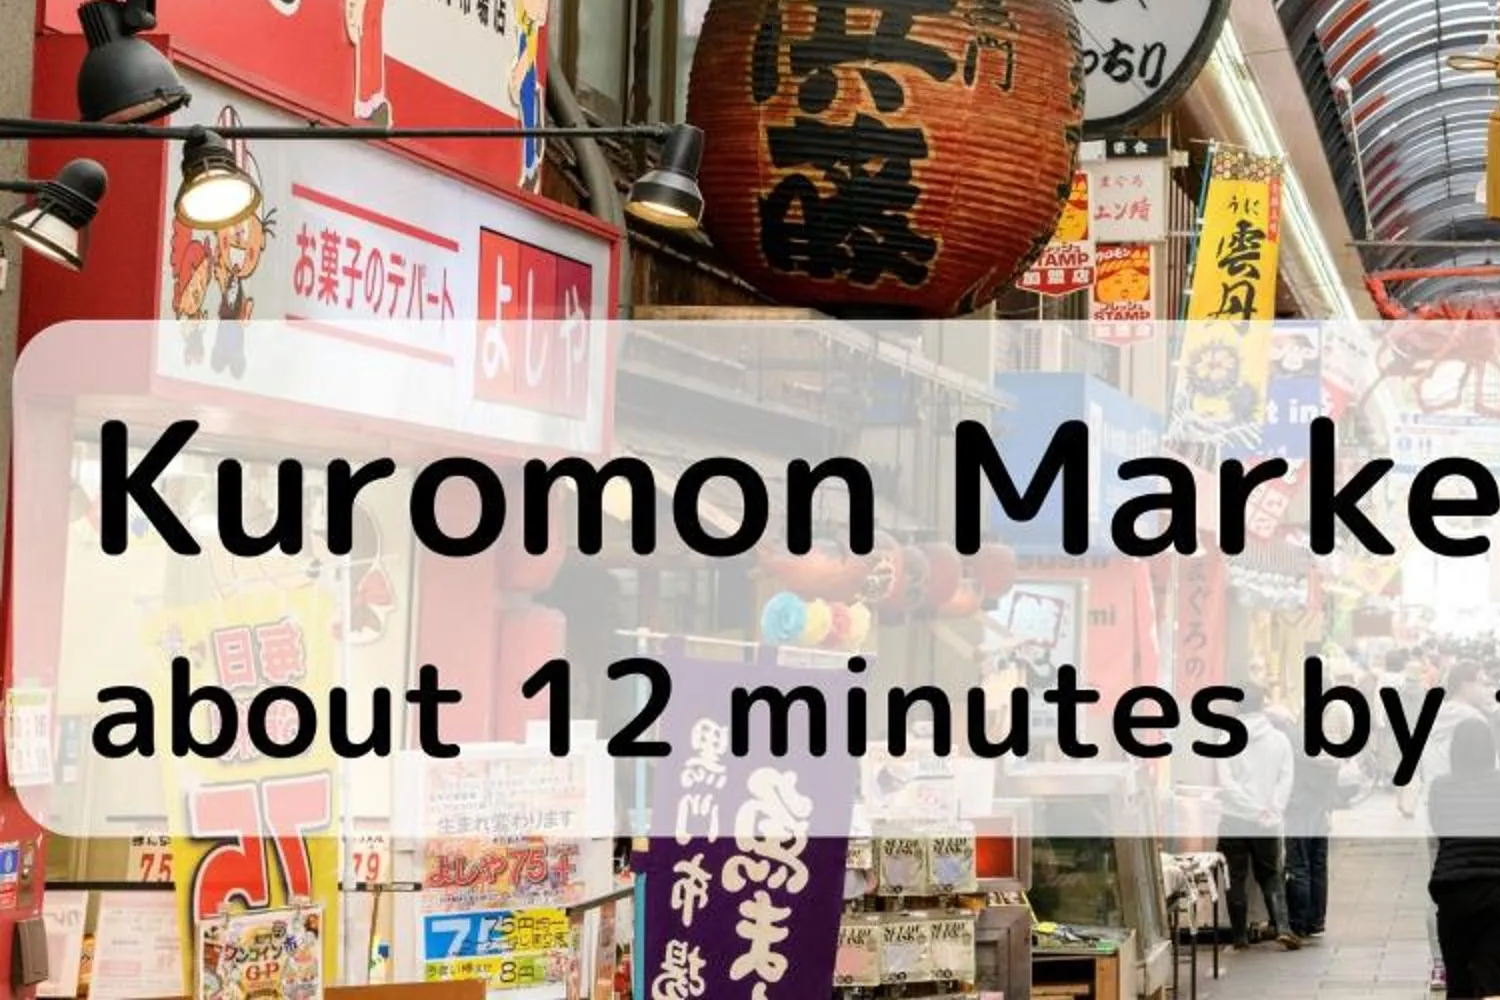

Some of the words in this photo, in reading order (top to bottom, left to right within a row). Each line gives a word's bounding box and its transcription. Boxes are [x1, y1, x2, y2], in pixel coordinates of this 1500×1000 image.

[1228, 194, 1261, 217] うに
[1032, 253, 1090, 266] TAMP
[1093, 311, 1151, 321] STAMP
[481, 254, 588, 399] よしや
